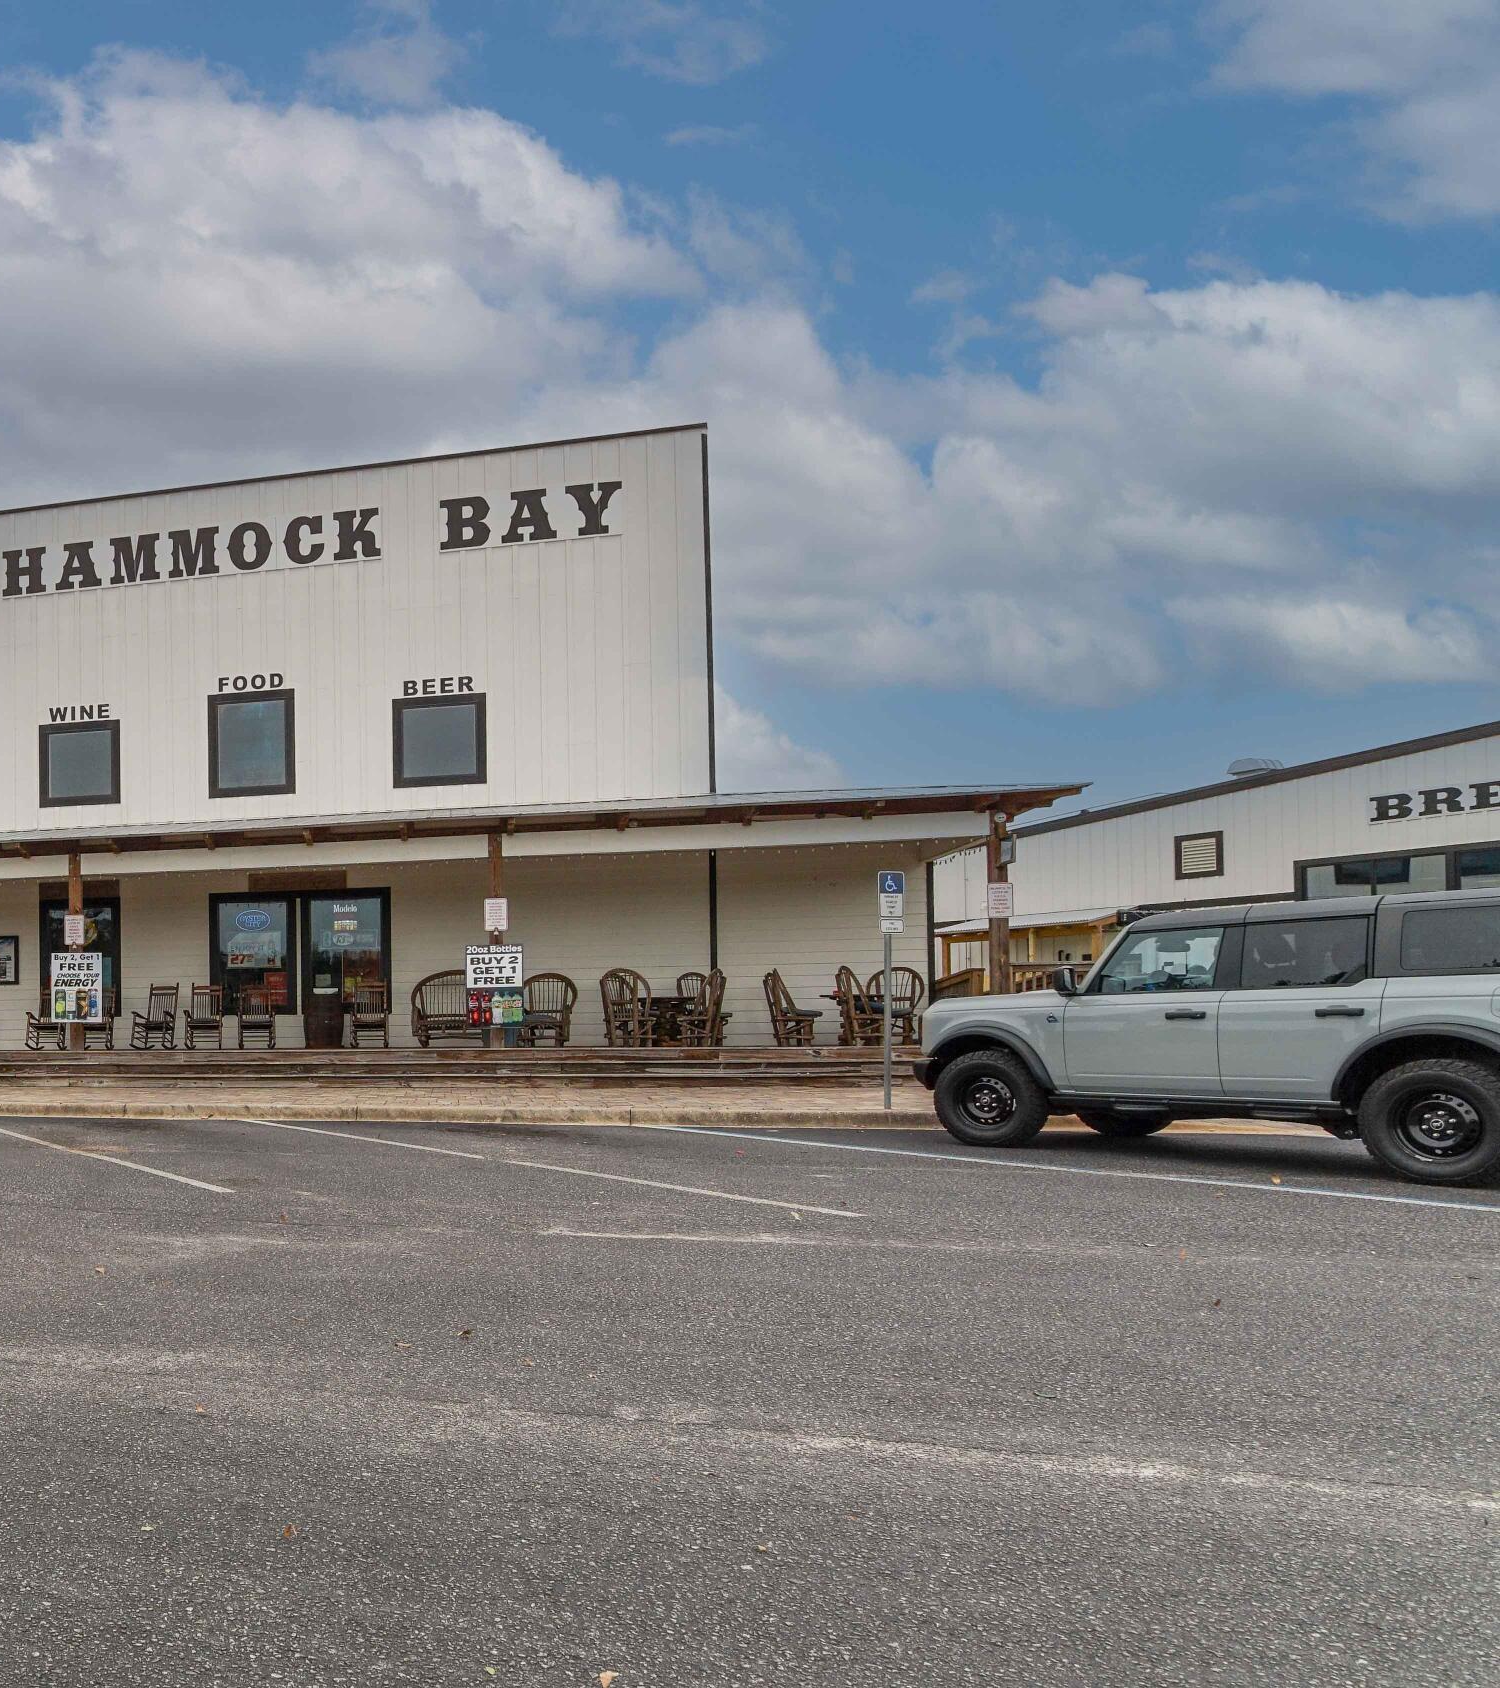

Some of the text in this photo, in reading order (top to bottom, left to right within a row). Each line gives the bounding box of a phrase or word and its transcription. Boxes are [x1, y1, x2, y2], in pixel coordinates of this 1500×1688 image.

[2, 481, 623, 597] HAMMOCK BAY
[218, 673, 284, 692] FOOD
[403, 676, 474, 696] BEER
[49, 704, 110, 722] WINE
[1369, 781, 1500, 822] BRE
[333, 904, 358, 913] Modelo
[466, 944, 522, 954] 20oz Bottles
[54, 954, 68, 962] Buy
[79, 953, 94, 961] Get
[95, 953, 100, 961] 1
[470, 955, 519, 965] BUY 2
[59, 962, 94, 971] FREE
[472, 965, 517, 975] GET 1
[54, 979, 98, 987] ENERGY
[473, 976, 515, 985] FREE
